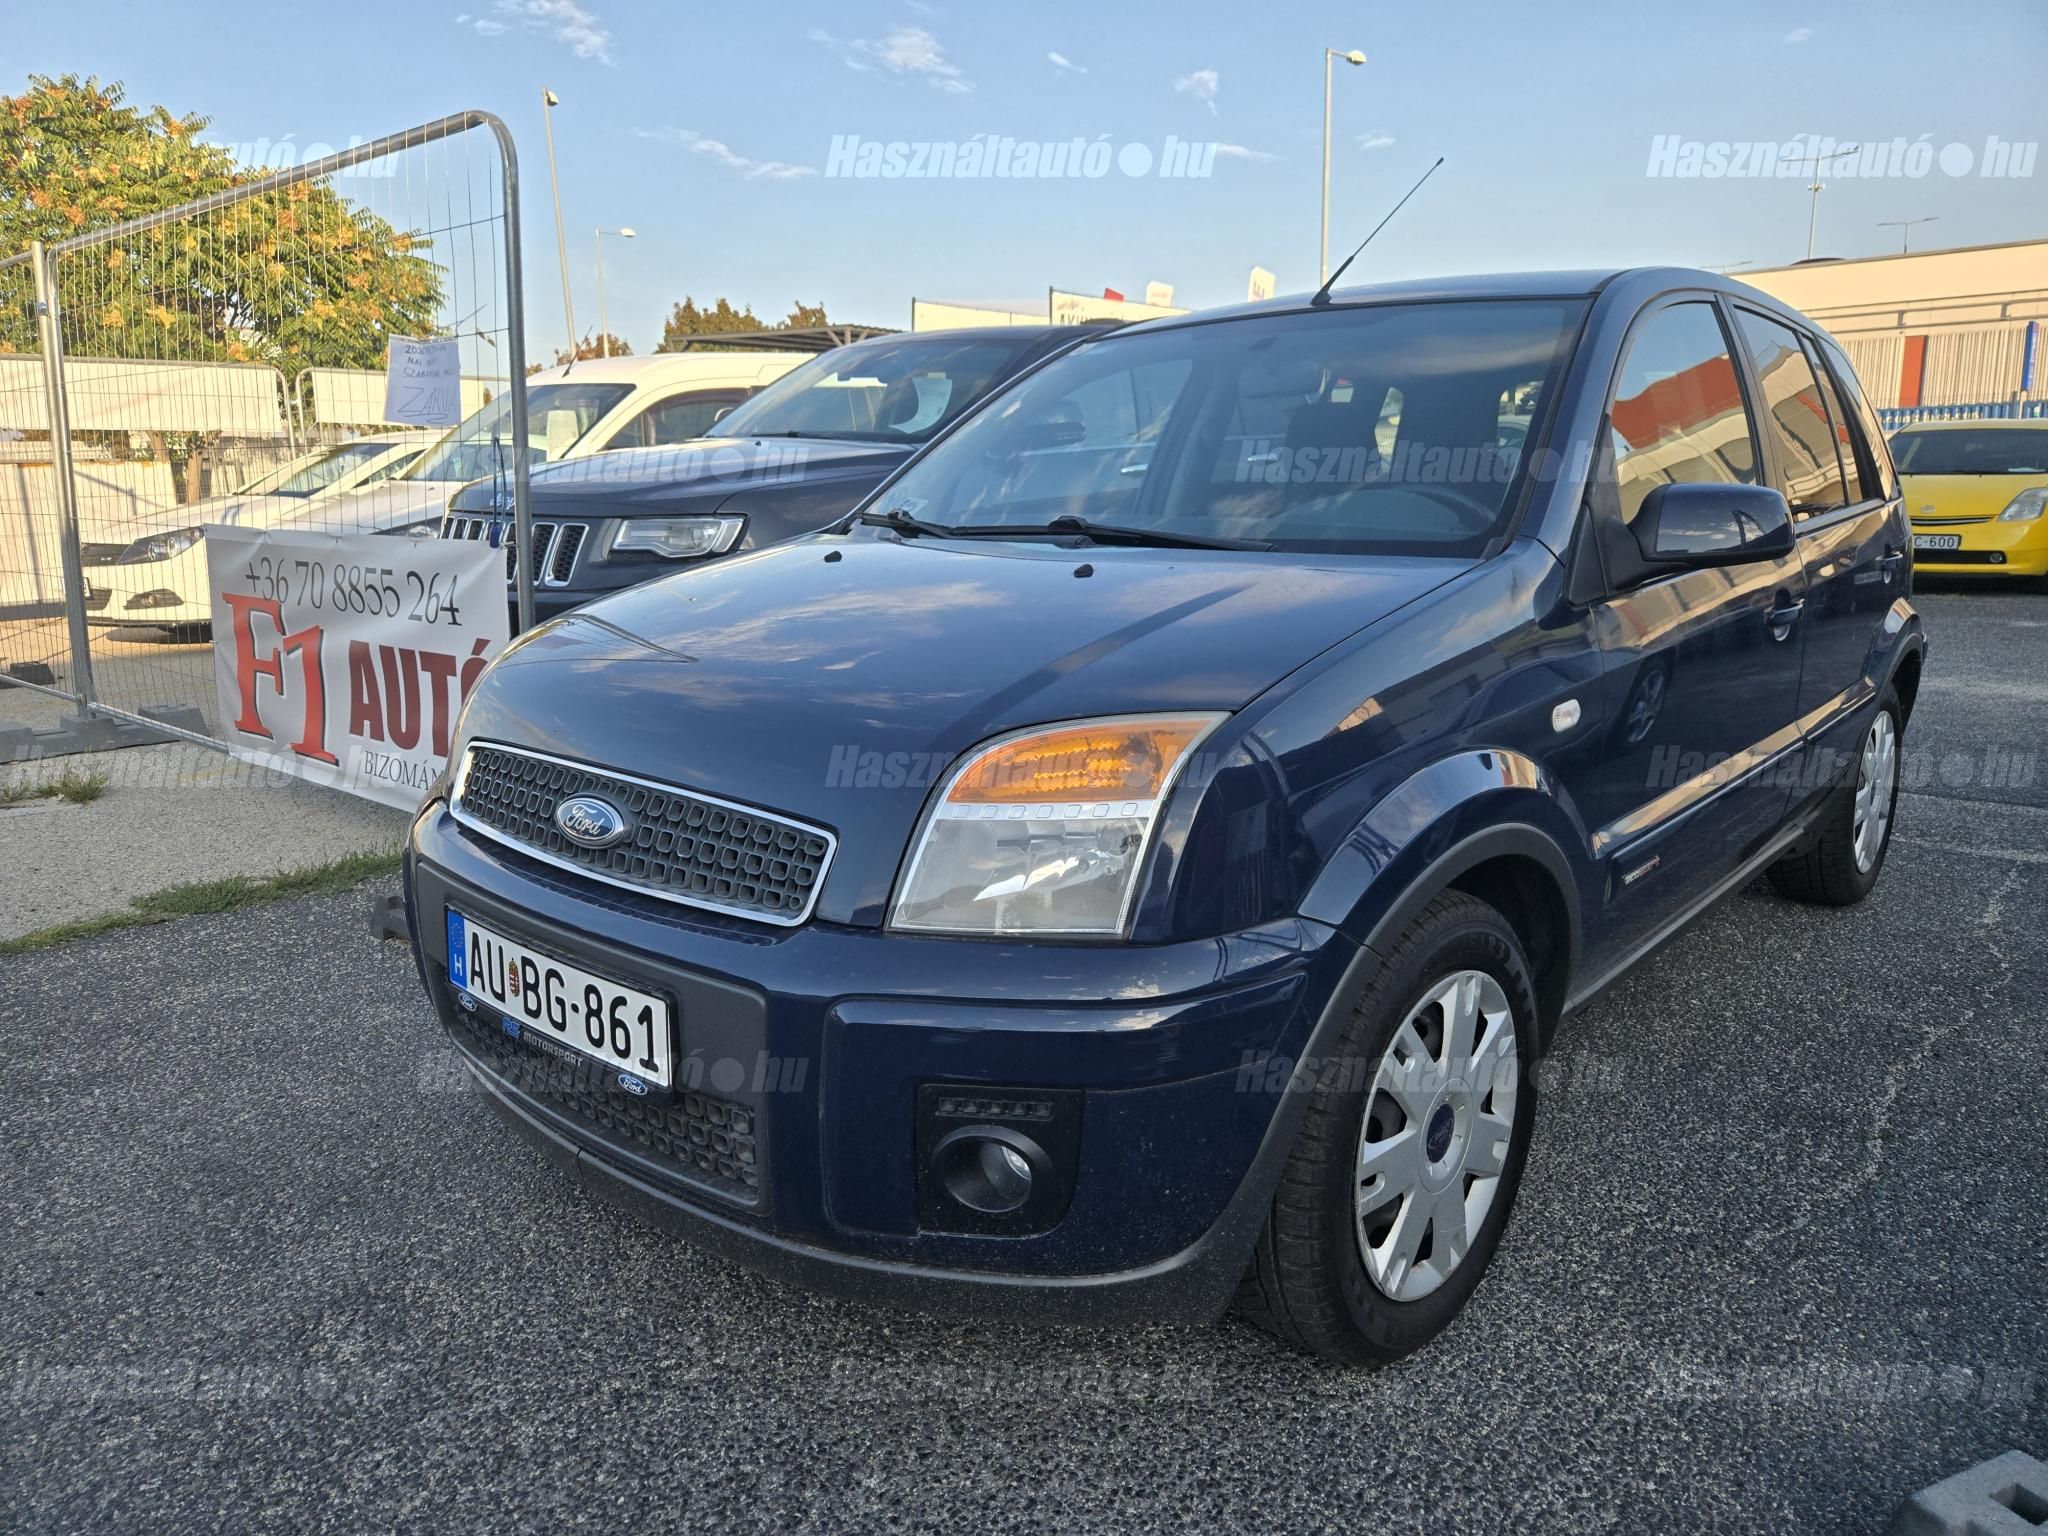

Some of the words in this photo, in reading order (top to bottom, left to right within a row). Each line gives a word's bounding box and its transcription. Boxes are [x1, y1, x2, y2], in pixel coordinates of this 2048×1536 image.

[245, 556, 289, 603] +36
[295, 560, 325, 609] 70
[332, 563, 400, 618] 8855
[407, 570, 462, 626] 264
[221, 592, 339, 767] F1
[565, 804, 606, 835] Ford
[453, 953, 463, 977] H
[523, 1031, 584, 1067] MOTORSPORT
[620, 1075, 645, 1094] Ford
